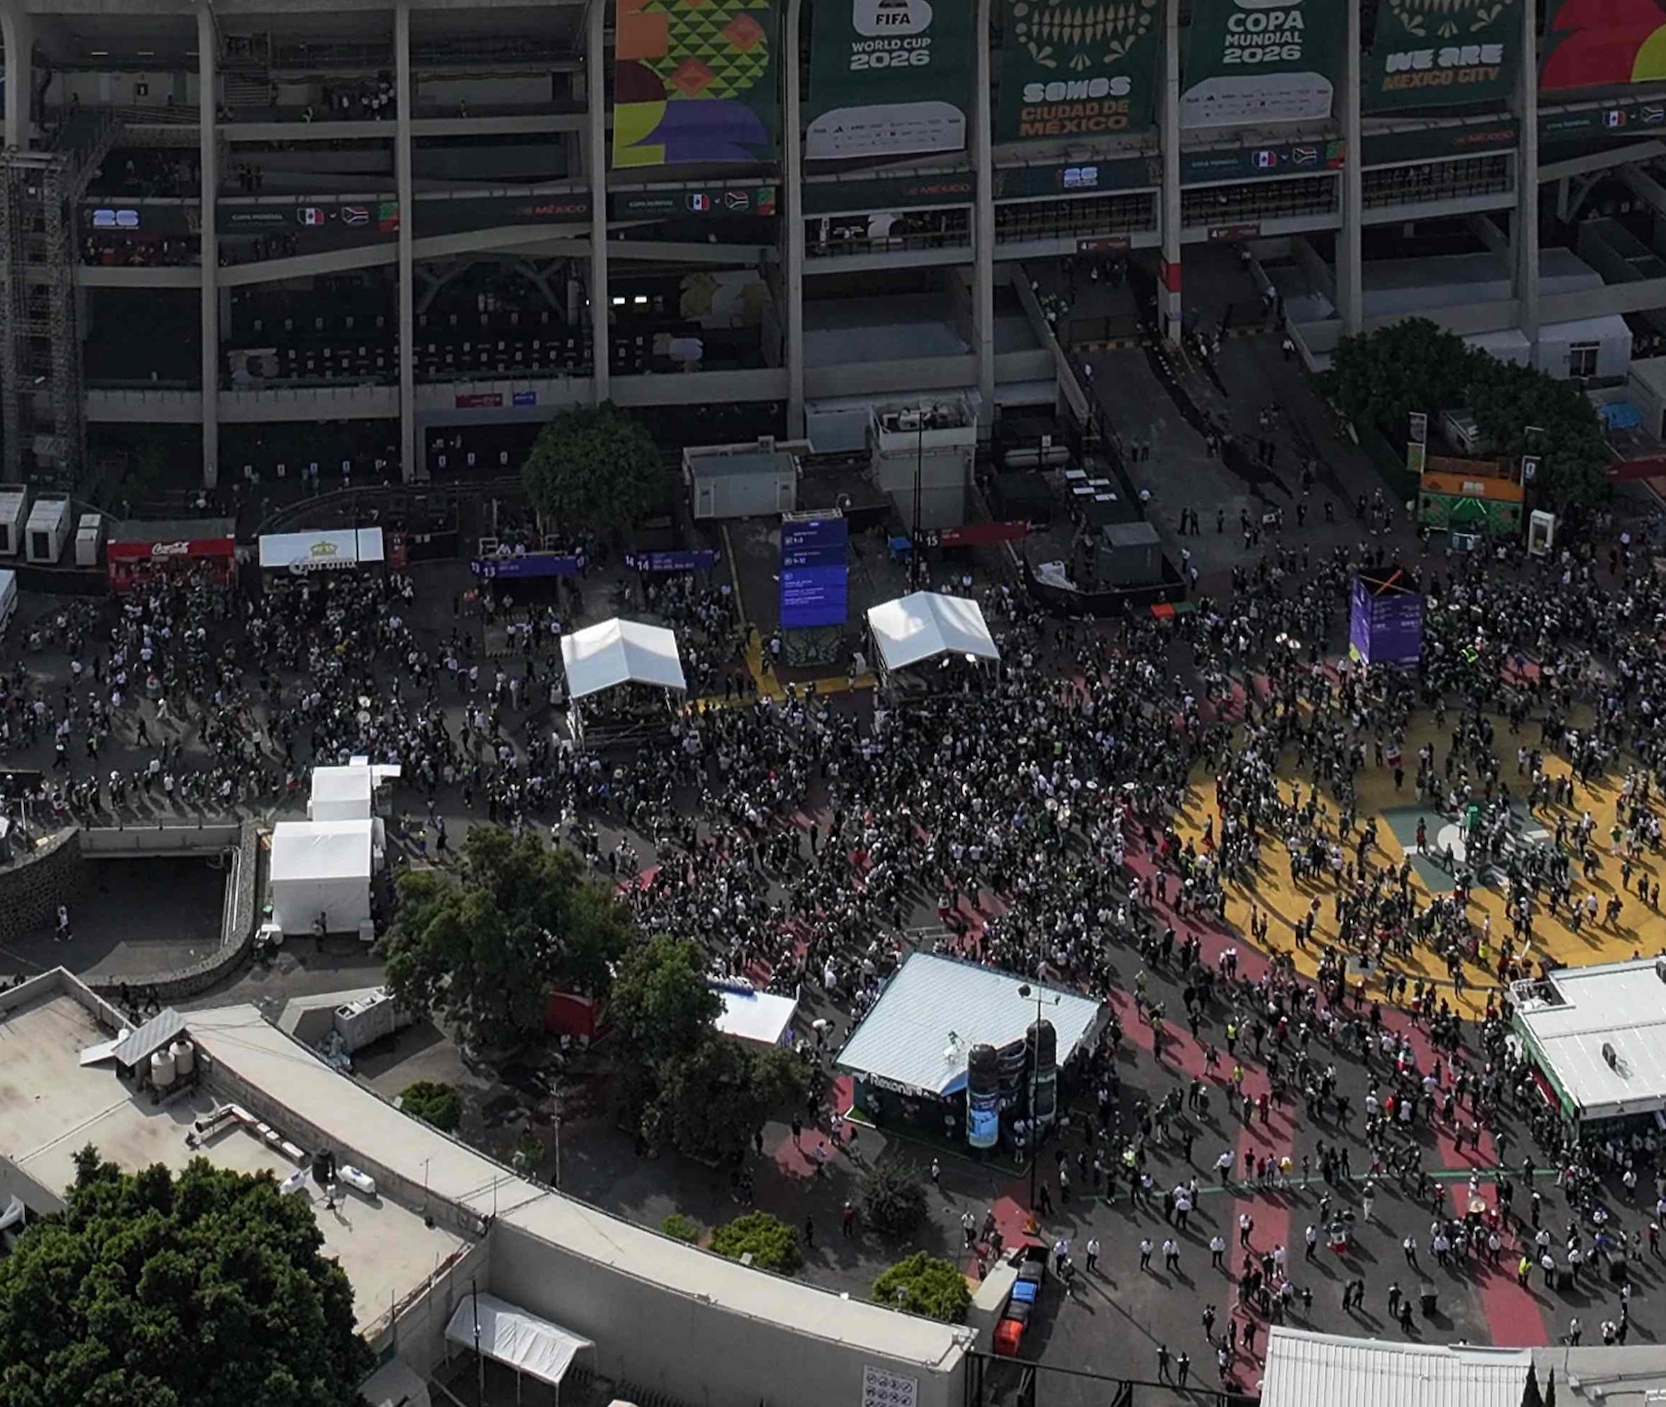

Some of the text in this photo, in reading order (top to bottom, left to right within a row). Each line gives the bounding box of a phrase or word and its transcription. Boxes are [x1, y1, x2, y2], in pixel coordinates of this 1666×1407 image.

[876, 13, 911, 25] FIFA
[1227, 10, 1305, 32] COPA
[851, 37, 932, 53] WORLD CUP
[1225, 31, 1303, 46] MUNDIAL
[849, 49, 931, 70] 2026
[1222, 44, 1302, 64] 2026
[1022, 75, 1132, 103] SOMOS
[1381, 67, 1501, 92] MEXICO CITY
[1020, 100, 1130, 121] CIUDAD DE
[1019, 115, 1129, 137] MÉXICO
[925, 535, 938, 547] 15
[288, 556, 358, 576] Corona
[483, 566, 496, 577] 13
[637, 560, 649, 572] 14
